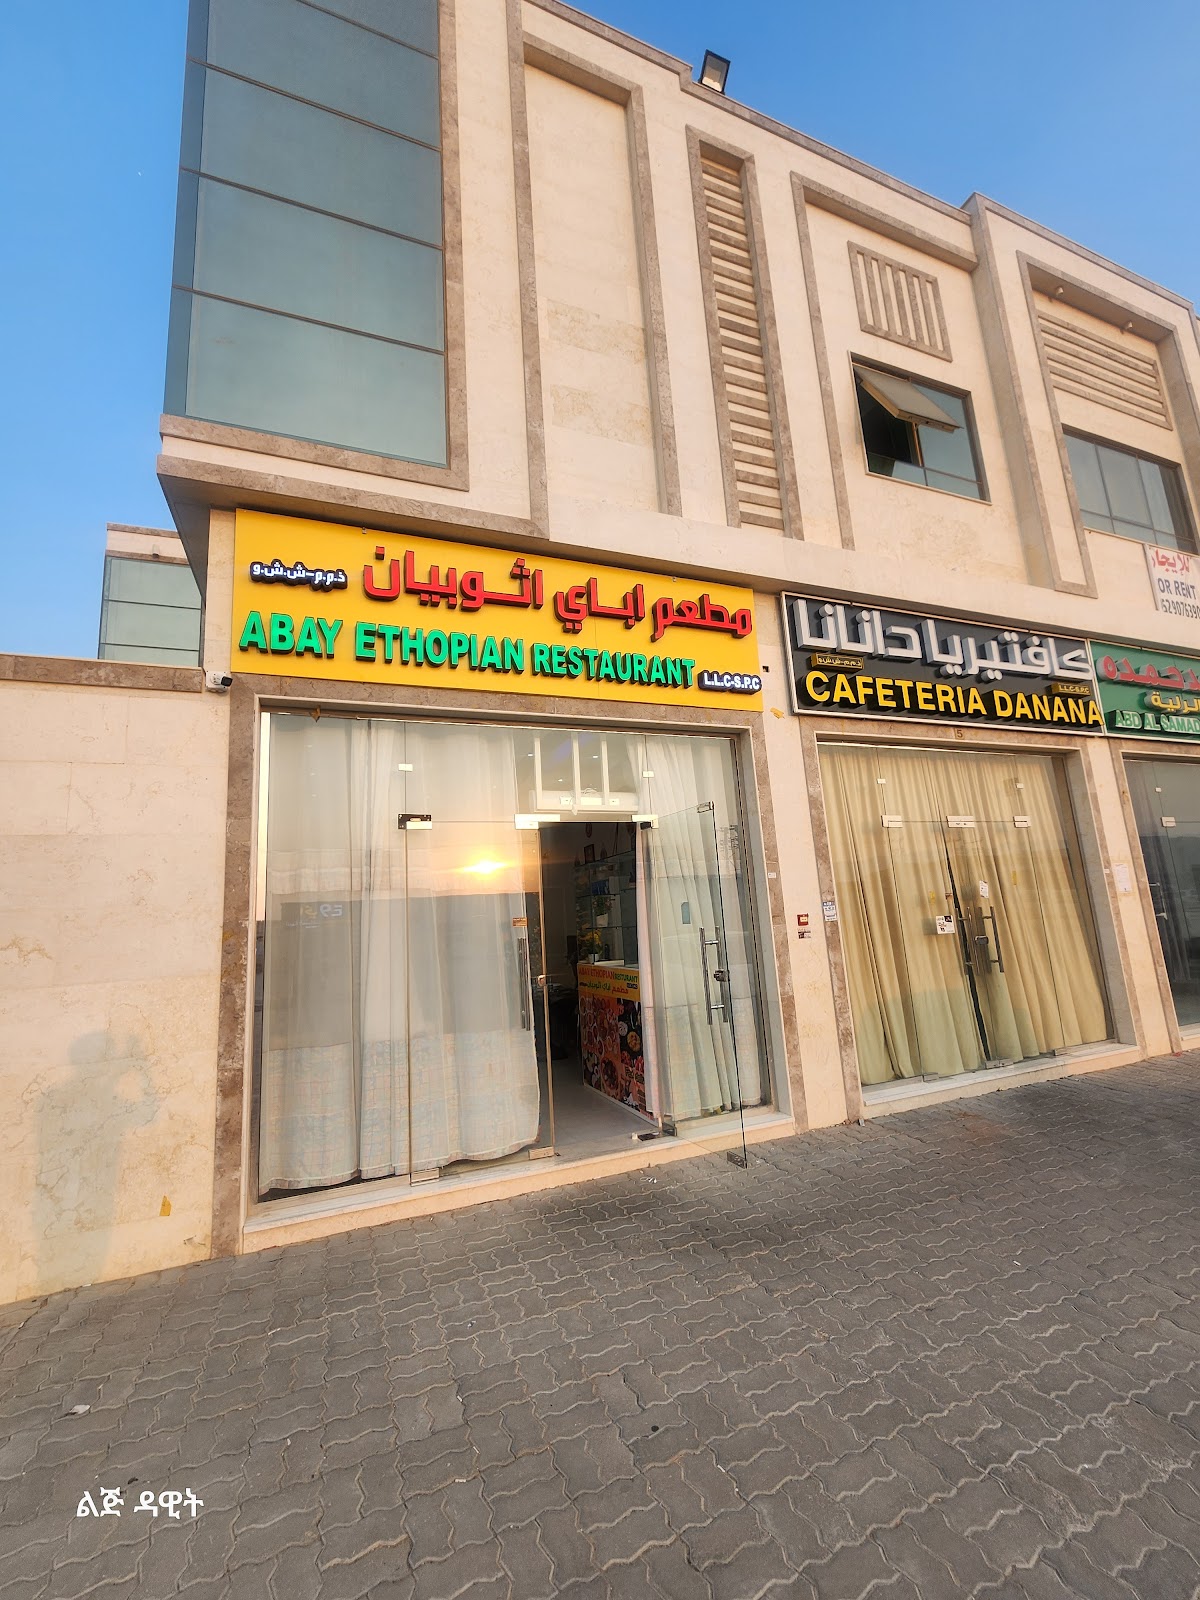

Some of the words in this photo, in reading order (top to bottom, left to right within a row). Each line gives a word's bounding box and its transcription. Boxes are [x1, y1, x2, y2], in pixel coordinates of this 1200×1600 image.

[363, 546, 543, 611] اثوبيان
[555, 577, 645, 633] اباي
[1174, 580, 1197, 600] RENT
[652, 594, 752, 642] مطعم
[239, 611, 343, 658] ABAY
[355, 621, 524, 674] ETHOPIAN
[532, 643, 695, 689] RESTAURANT
[921, 619, 1093, 681] كافتيريا
[805, 670, 987, 715] CAFETERIA
[993, 689, 1104, 726] DANANA
[1116, 710, 1142, 729] ABD
[1144, 713, 1161, 731] AL
[956, 729, 963, 739] 5
